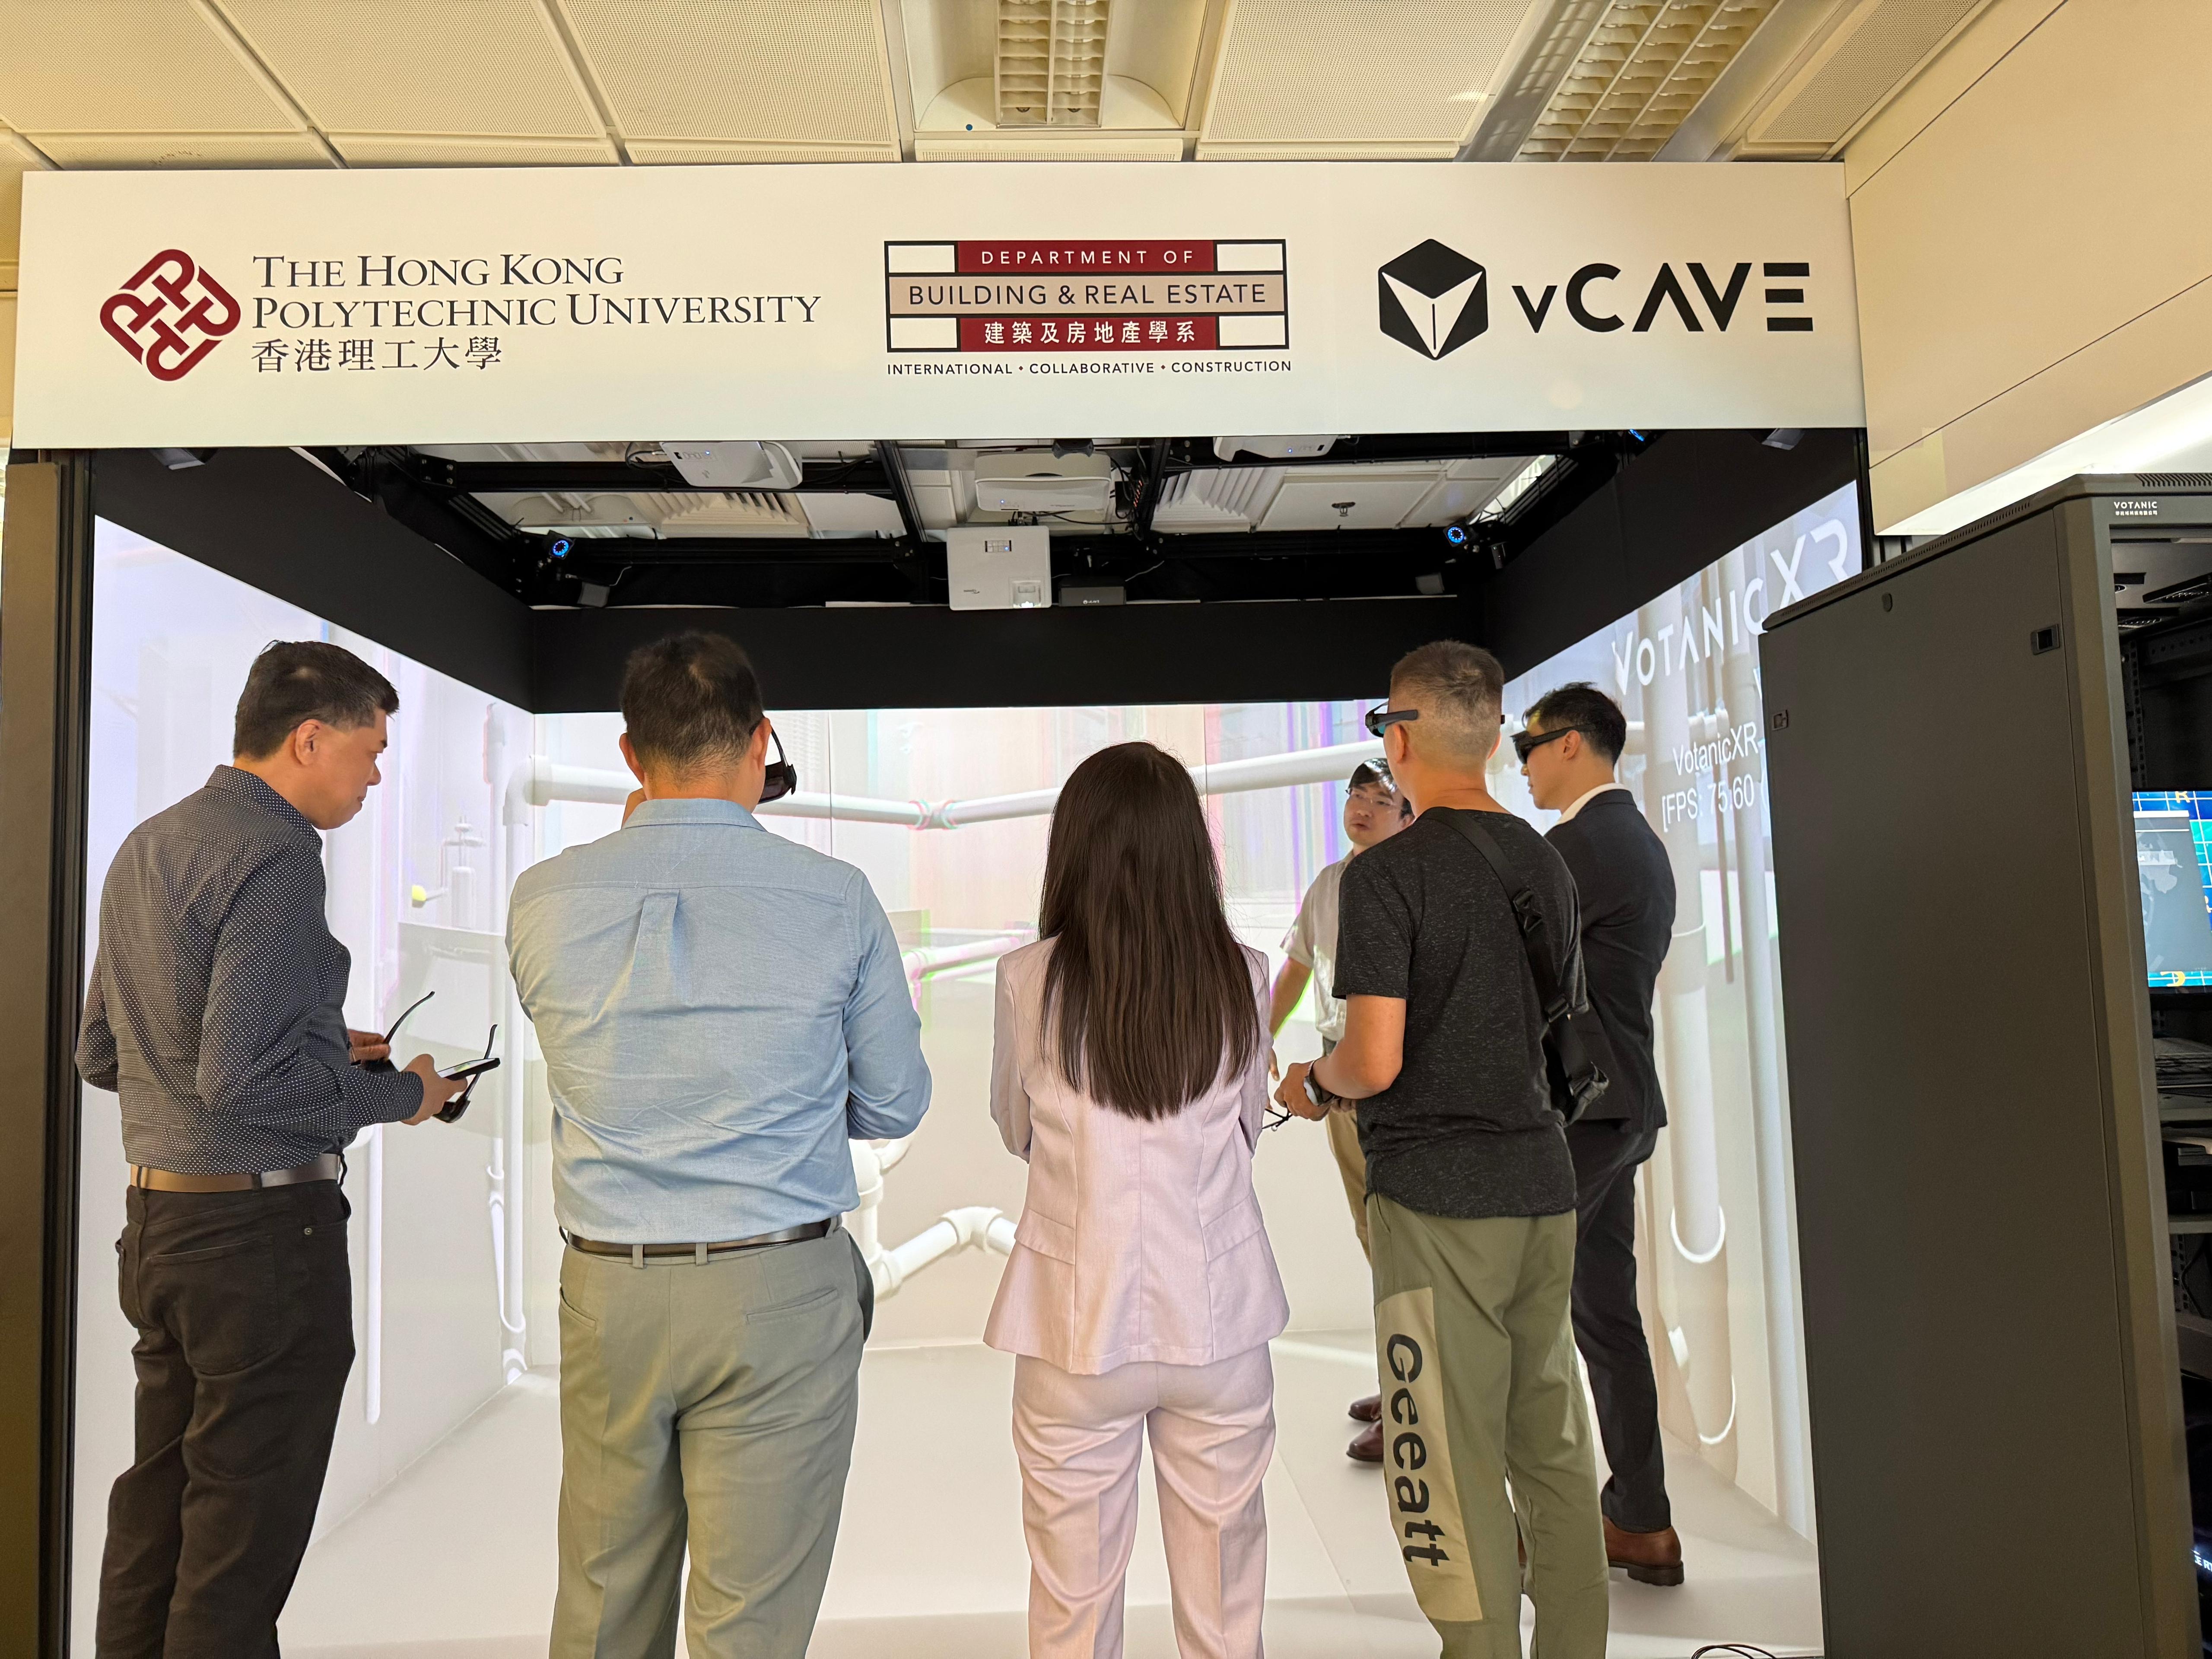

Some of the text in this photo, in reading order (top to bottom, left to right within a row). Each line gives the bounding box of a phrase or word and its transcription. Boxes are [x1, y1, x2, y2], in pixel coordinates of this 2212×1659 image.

[253, 254, 624, 288] THE HONG KONG
[982, 251, 1193, 264] DEPARTMENT OF
[252, 293, 821, 328] POLYTECHNIC UNIVERSITY
[909, 284, 1266, 305] BUILDING & REAL ESTATE
[1511, 262, 1813, 333] vCAVE
[984, 321, 1195, 344] 建築及房地產學系
[251, 336, 502, 373] 香港理工大學
[887, 361, 1291, 375] INTERNATIONAL COLLABORATIVE CONSTRUCTION
[1672, 721, 1758, 775] VotanicXR
[1386, 1333, 1450, 1567] Geeatt
